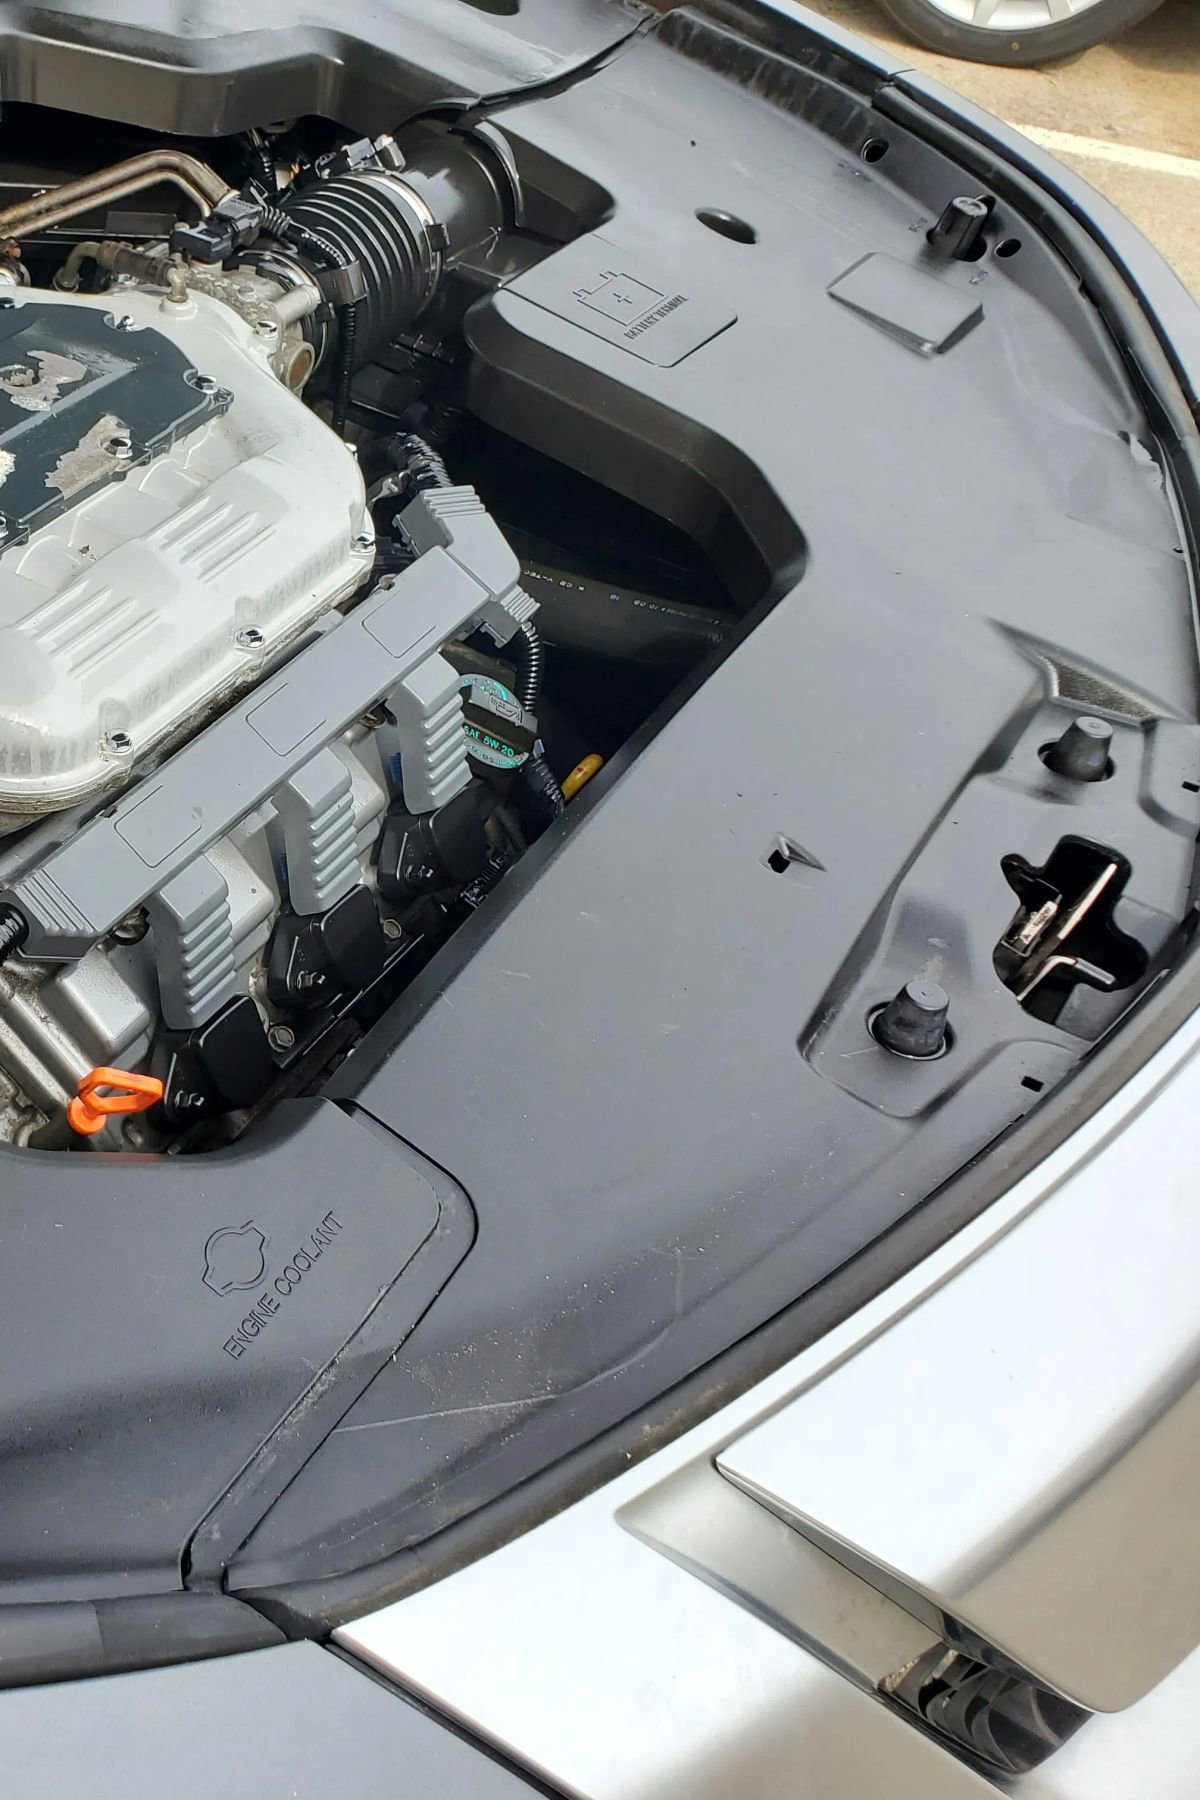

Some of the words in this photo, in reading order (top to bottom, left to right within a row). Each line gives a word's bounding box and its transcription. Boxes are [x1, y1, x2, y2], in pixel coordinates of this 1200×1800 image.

[483, 735, 515, 758] 5W-20
[222, 1292, 281, 1361] ENGINE
[274, 1210, 343, 1296] COOLANT
